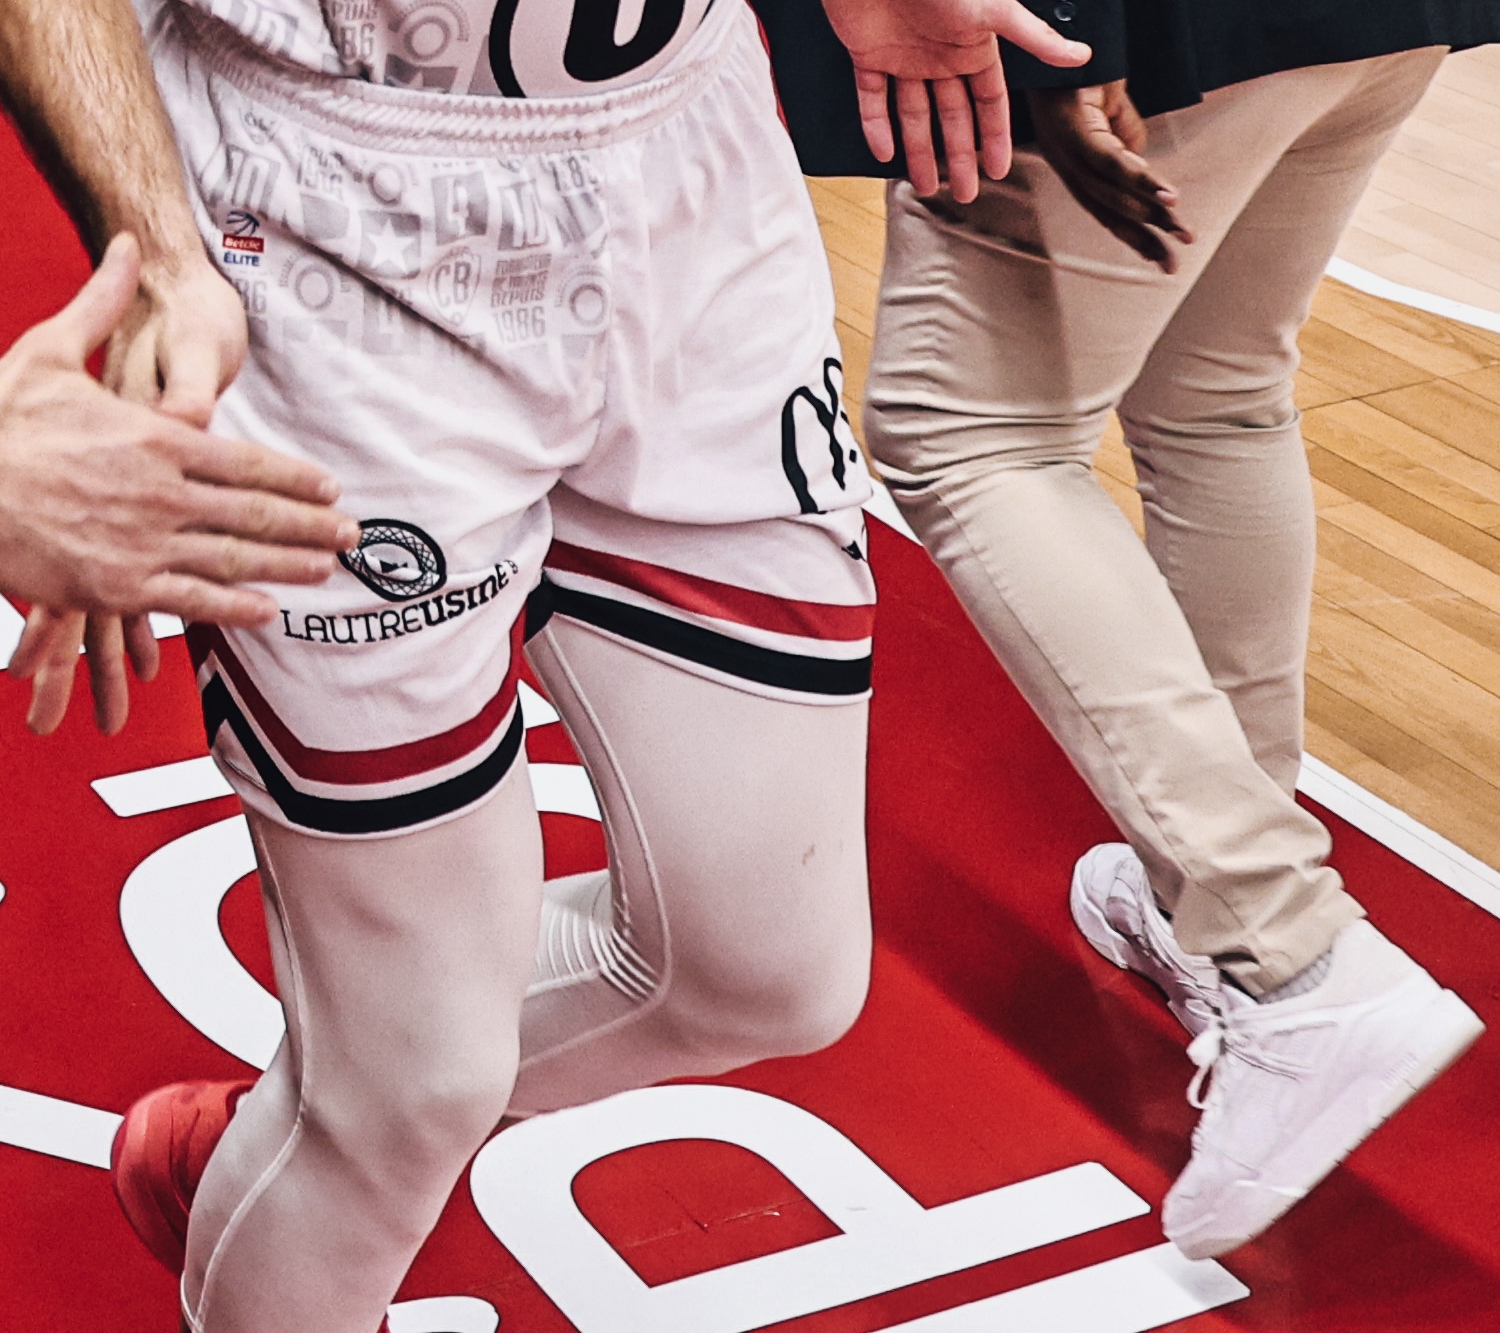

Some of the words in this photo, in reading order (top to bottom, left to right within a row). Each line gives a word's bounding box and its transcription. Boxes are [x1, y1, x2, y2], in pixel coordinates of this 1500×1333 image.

[223, 251, 260, 267] ÉLITE
[433, 262, 472, 307] CB
[495, 306, 546, 343] 1986
